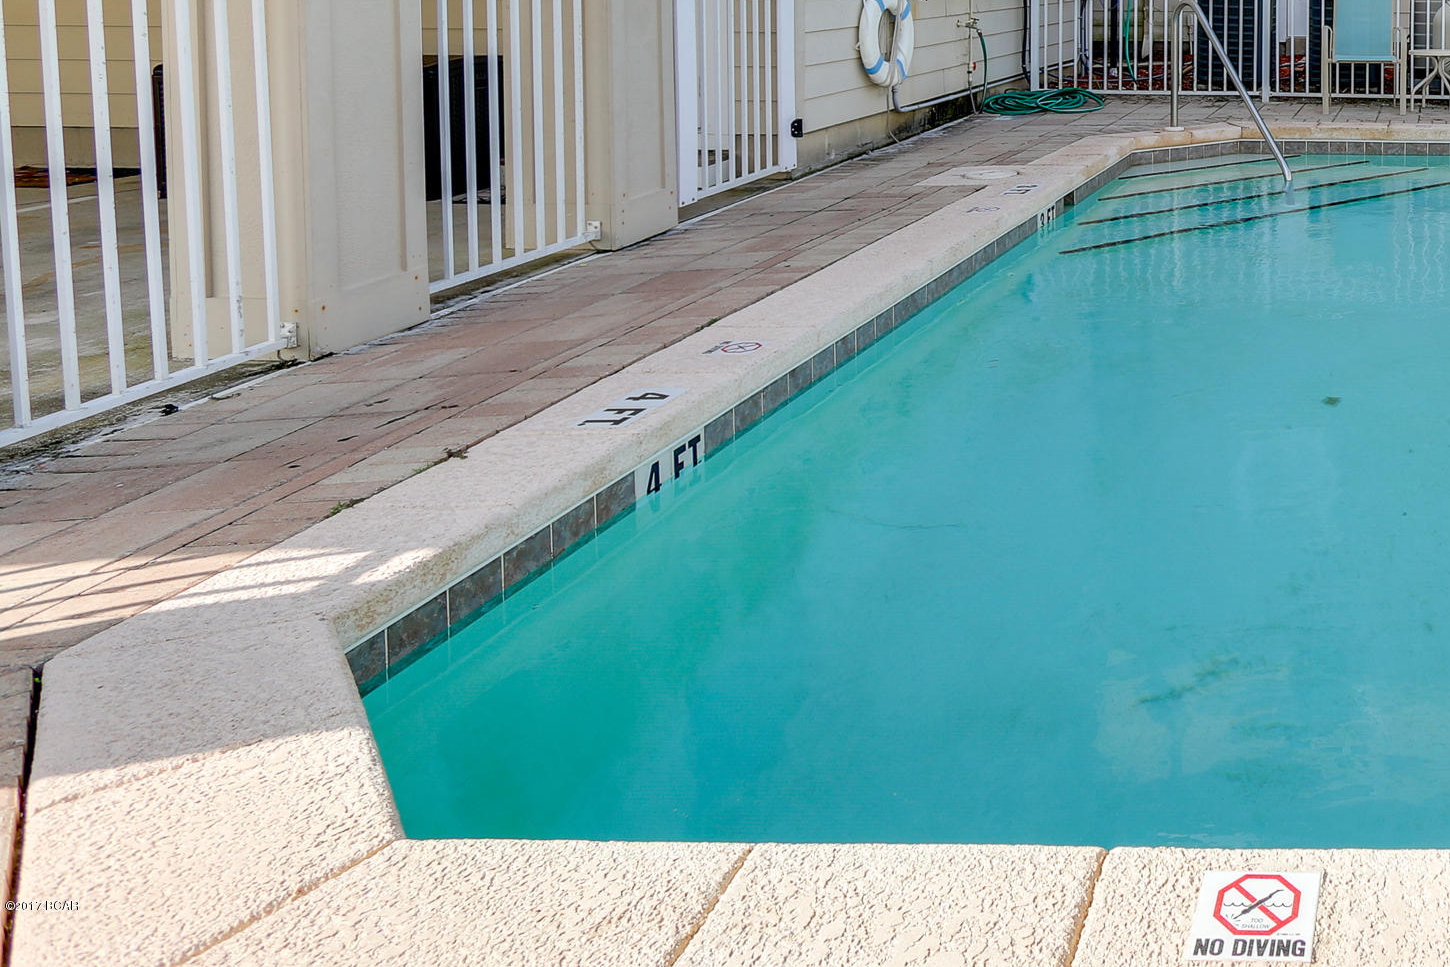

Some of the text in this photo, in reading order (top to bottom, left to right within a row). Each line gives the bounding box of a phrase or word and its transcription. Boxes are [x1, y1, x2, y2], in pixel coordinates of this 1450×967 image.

[647, 460, 662, 496] 4
[1193, 938, 1306, 957] NO DIVING
